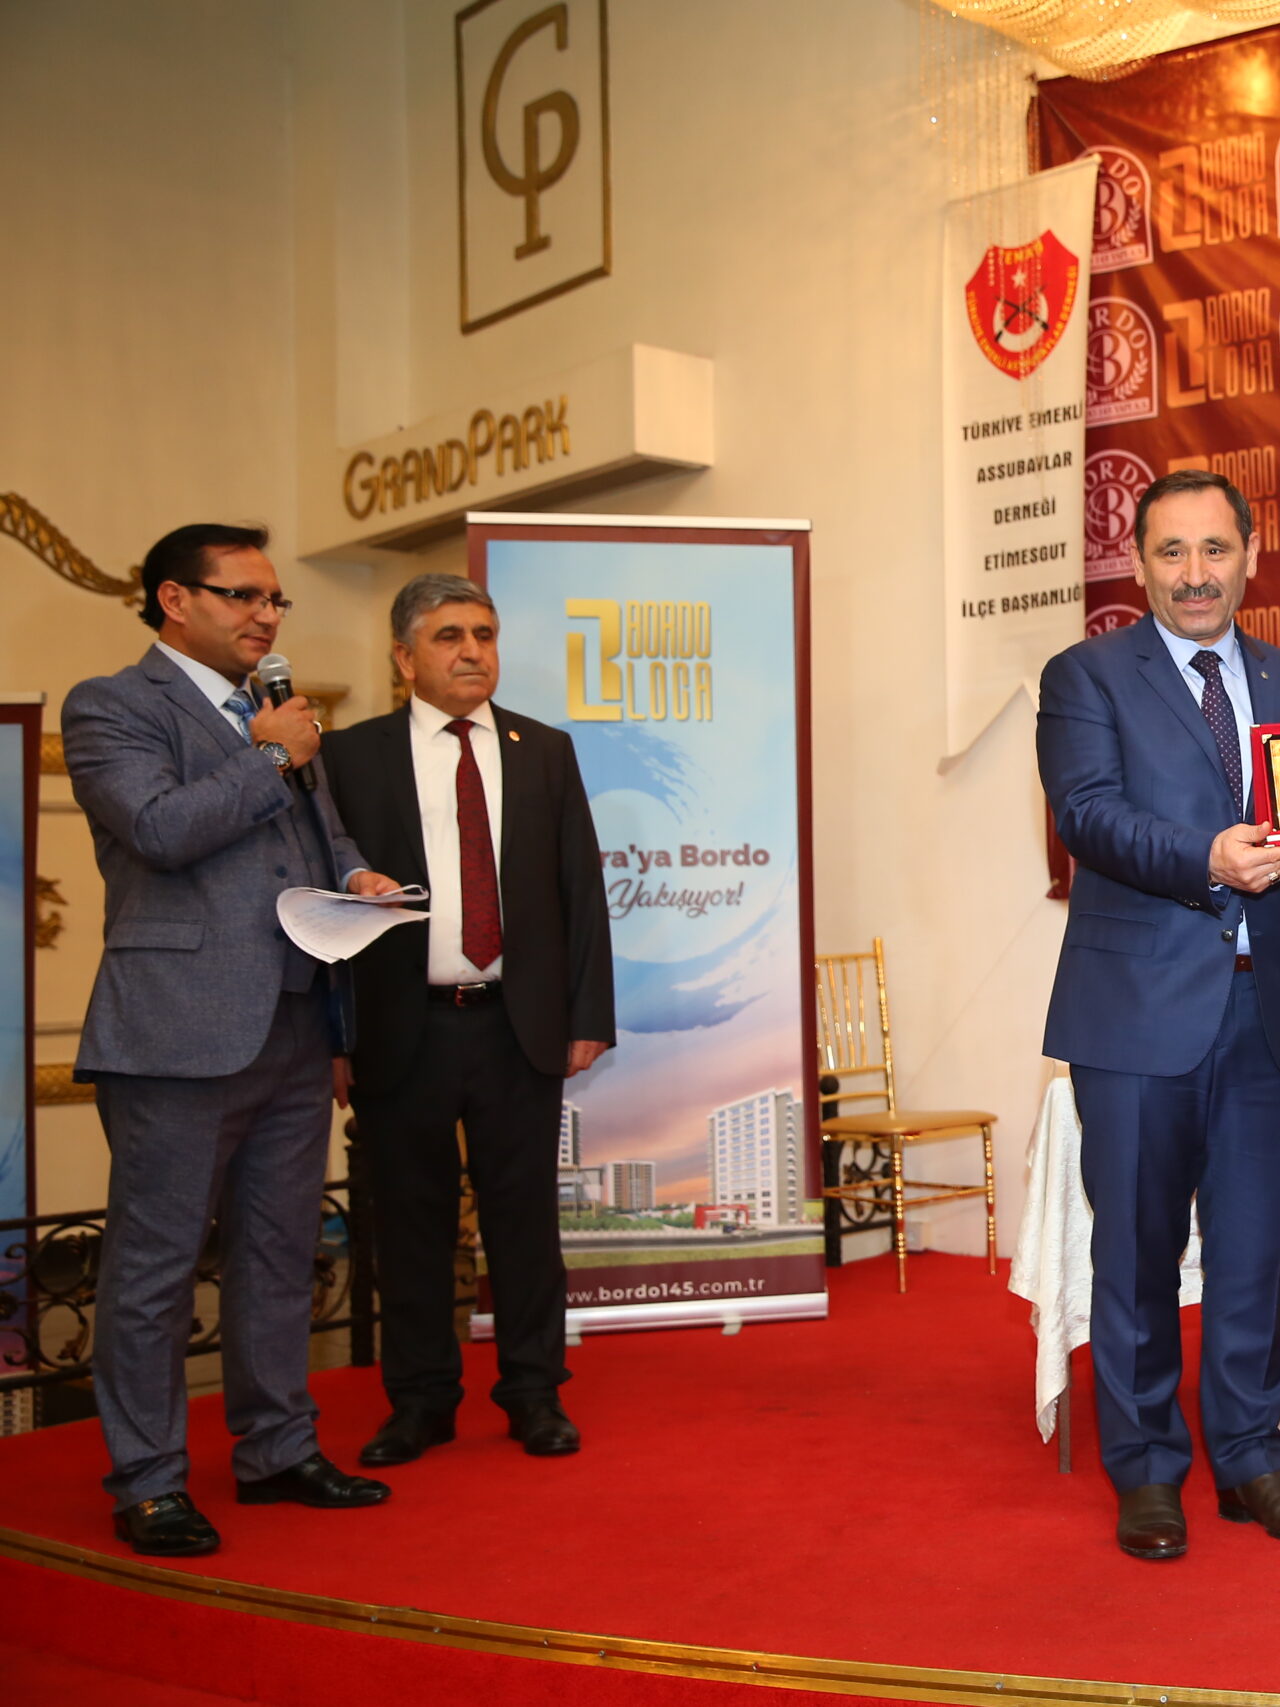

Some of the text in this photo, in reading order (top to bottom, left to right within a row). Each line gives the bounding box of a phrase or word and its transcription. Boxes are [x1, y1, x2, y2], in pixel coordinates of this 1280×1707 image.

[1208, 340, 1274, 400] LOCA
[962, 414, 1022, 441] TÜRKİYE
[977, 451, 1072, 483] ASSUBAYLAR
[994, 496, 1056, 525] DERNEĞİ
[984, 542, 1067, 571] ETİMESGUT
[962, 582, 1084, 618] İLÇE BAŞKANLIĞ
[626, 601, 711, 659] BORDO
[626, 661, 713, 721] LOCA
[599, 843, 770, 875] ra'ya Bordo
[566, 1278, 765, 1303] ww.bordo145.com.tr
